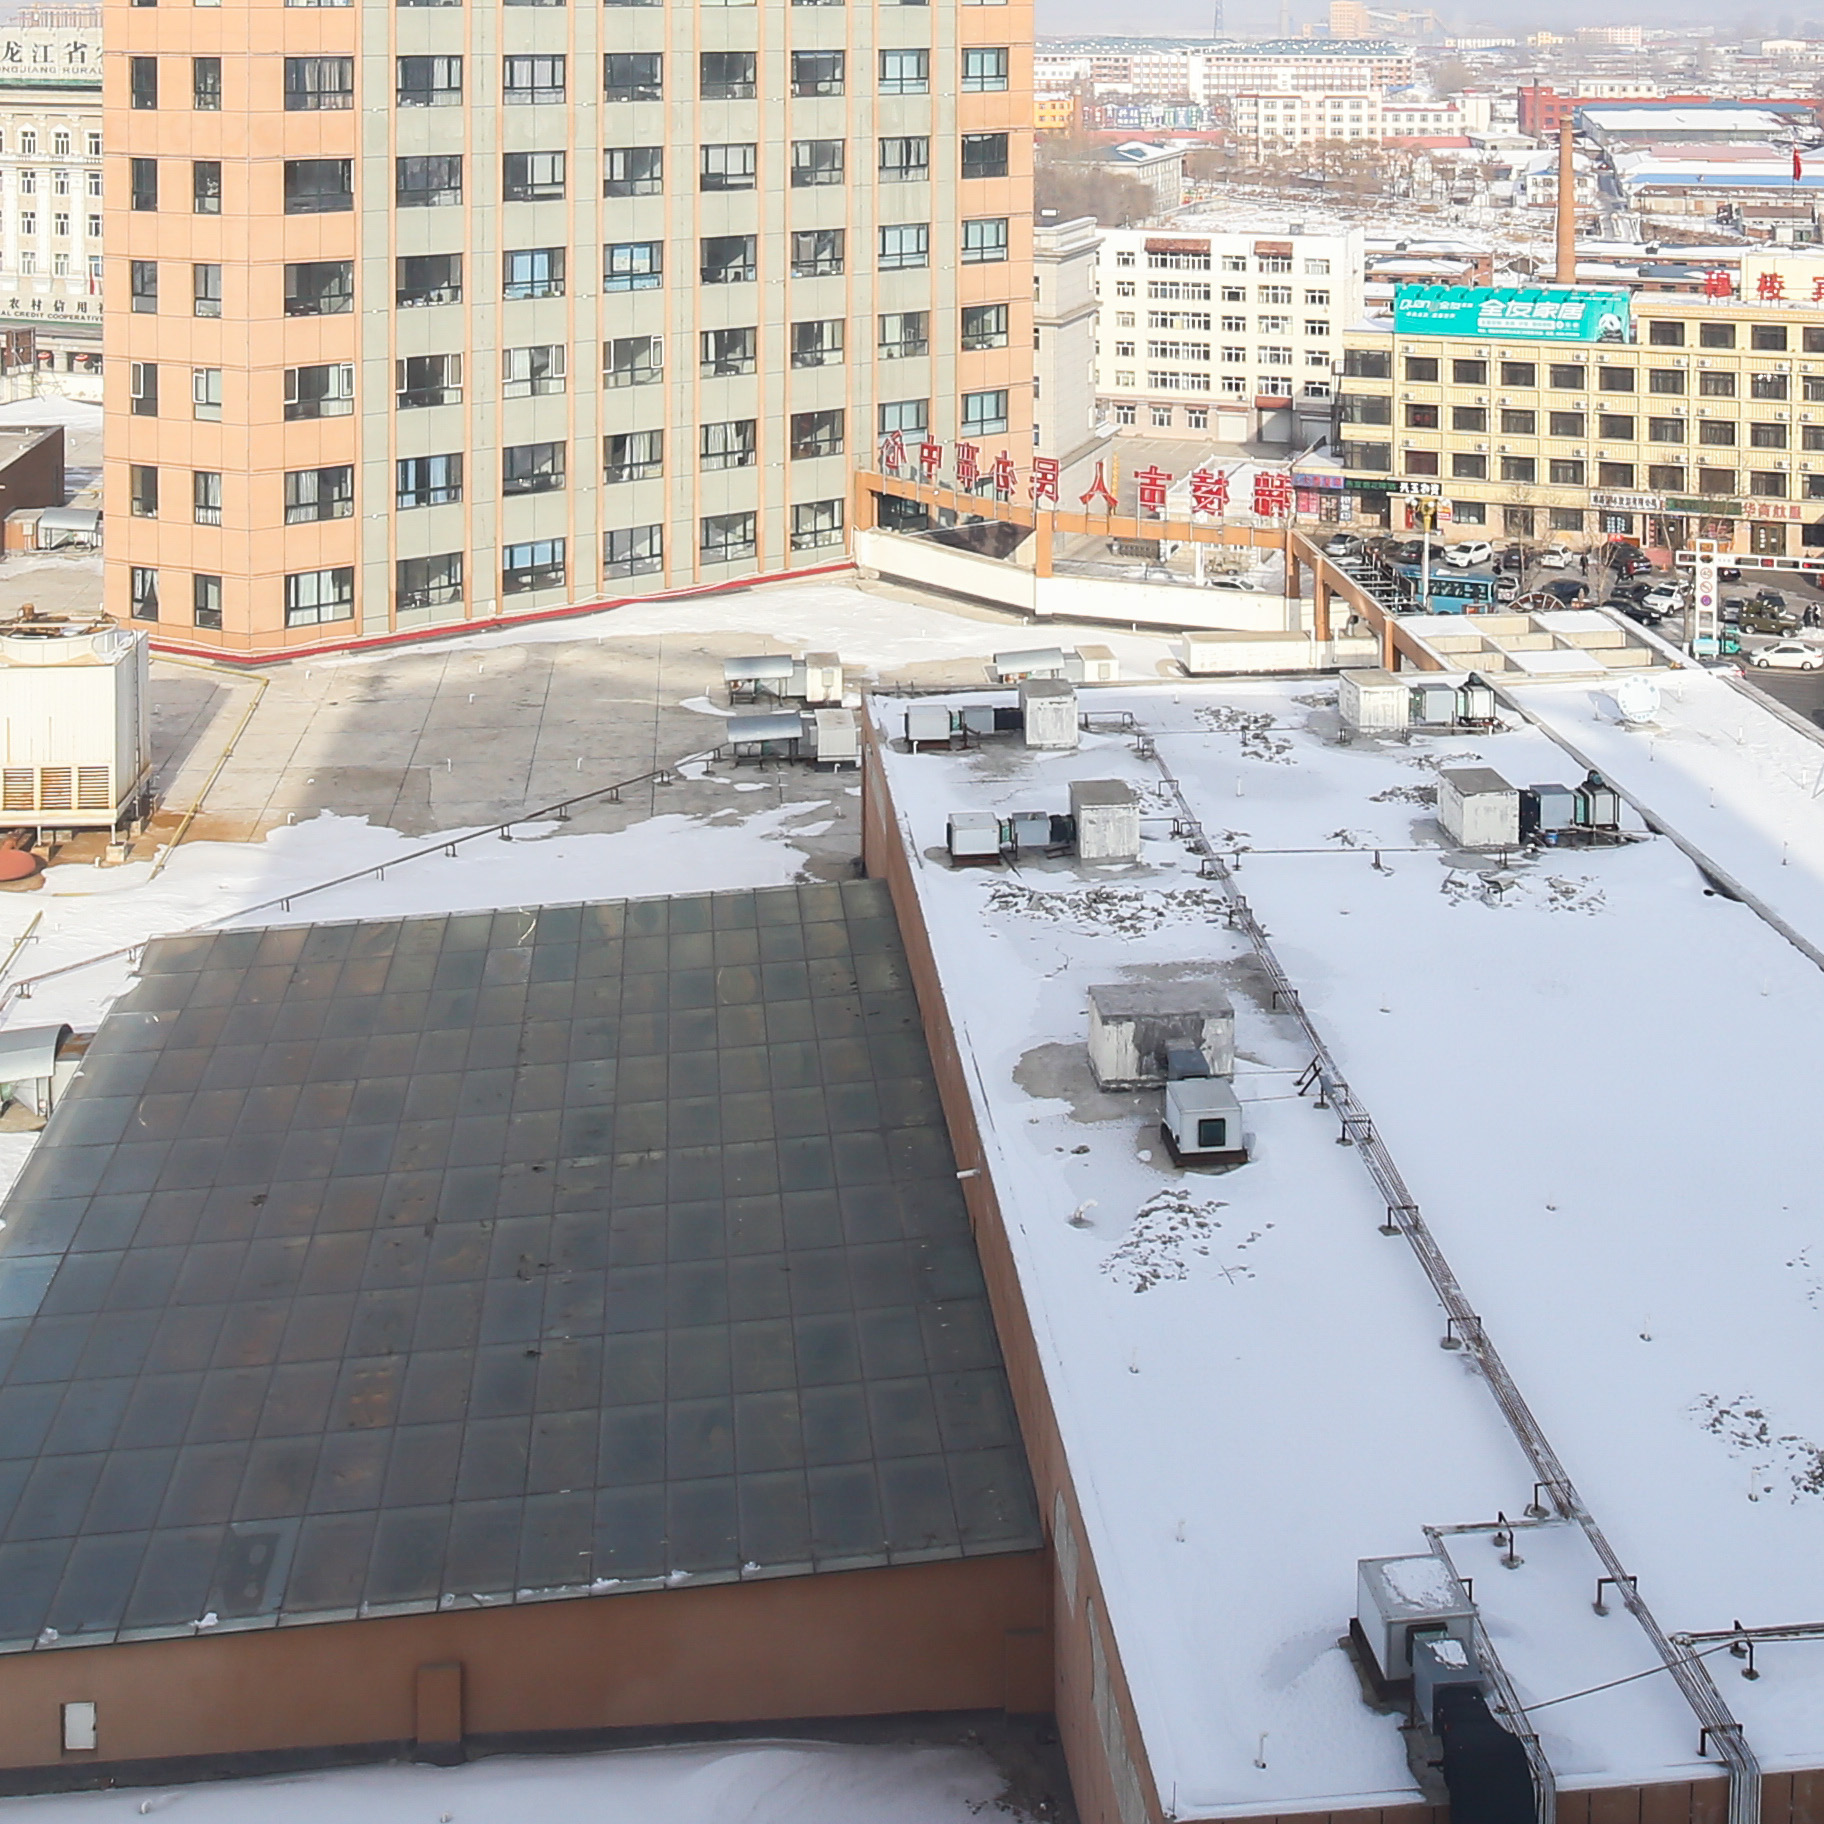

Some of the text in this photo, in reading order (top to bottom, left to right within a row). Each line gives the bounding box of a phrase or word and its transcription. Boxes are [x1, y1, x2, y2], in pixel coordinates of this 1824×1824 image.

[14, 311, 44, 319] CREDIT
[1478, 298, 1587, 321] 全友家居
